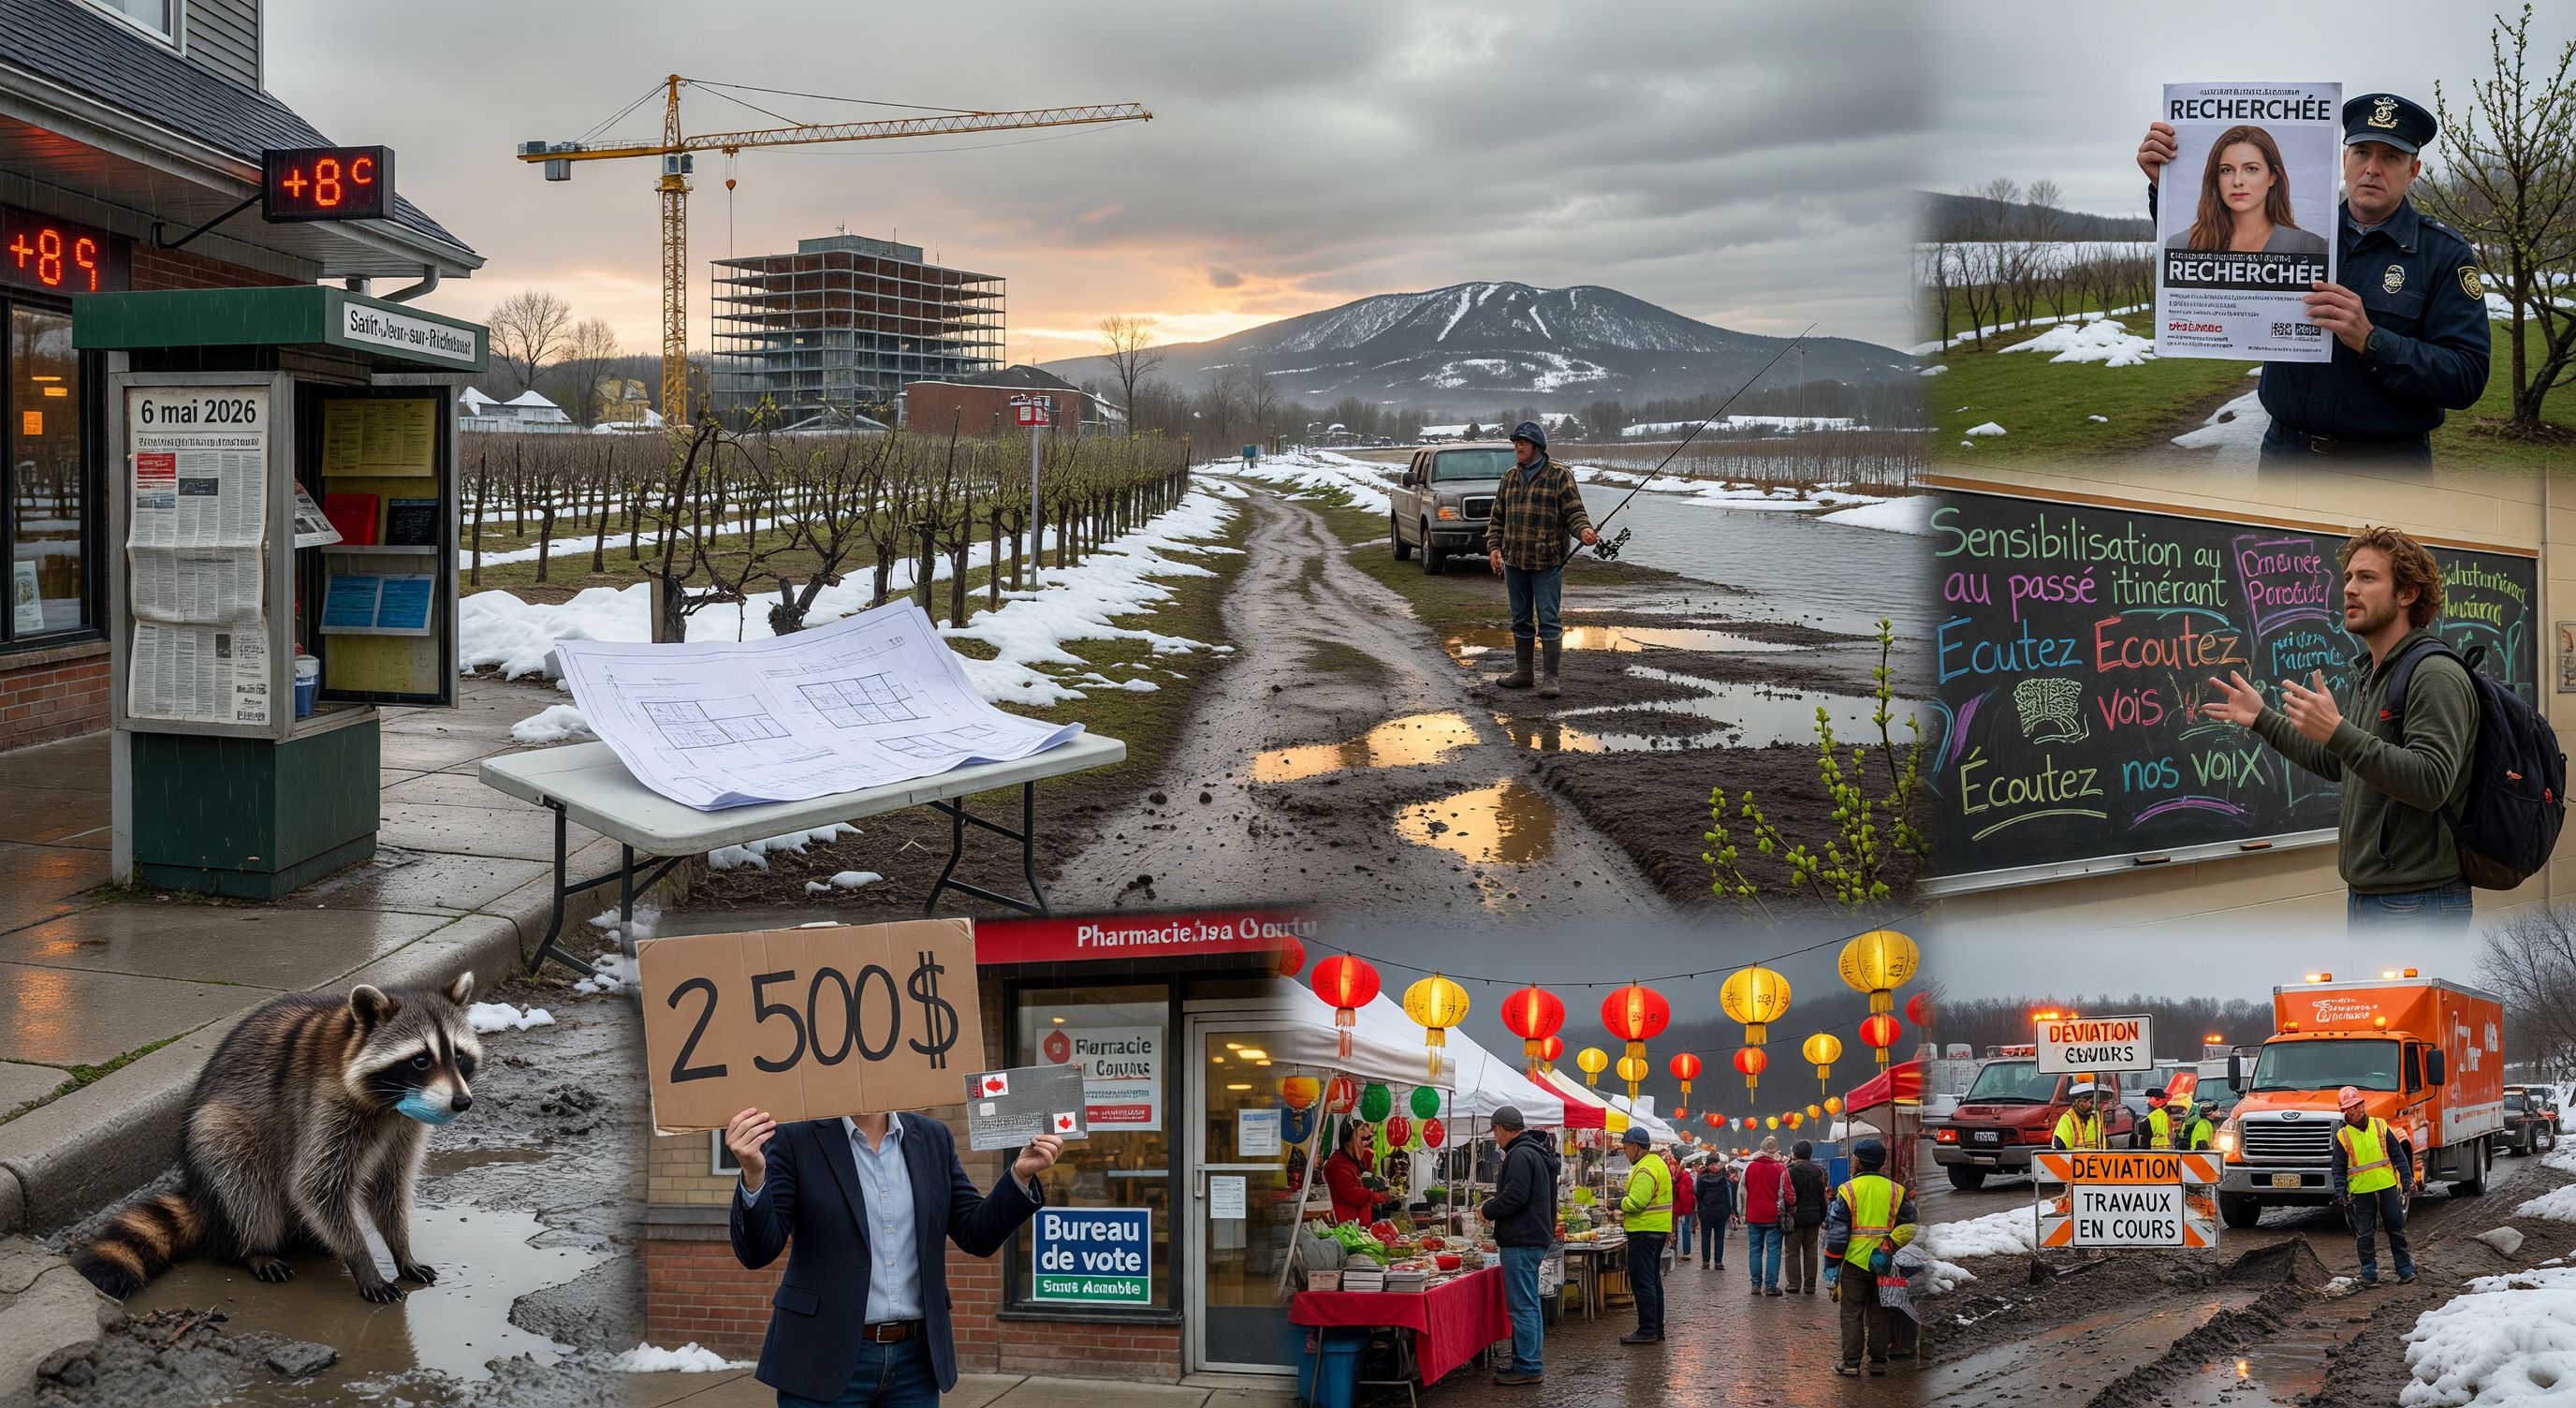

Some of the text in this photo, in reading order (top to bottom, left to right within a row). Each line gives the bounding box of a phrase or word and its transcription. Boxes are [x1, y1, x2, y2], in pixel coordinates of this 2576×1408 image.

[2170, 94, 2332, 121] RECHERCHÉE
[2168, 257, 2325, 285] RECHERCHÉE
[140, 399, 256, 424] 6 mai 2026
[1929, 506, 2221, 569] Sensibilisation au
[1944, 565, 2229, 623] au passé itinérant
[1960, 745, 2104, 815] Écoutez
[2122, 756, 2180, 793] nos
[1077, 921, 1192, 947] Pharmacie
[666, 976, 728, 1083] 2
[2049, 1020, 2140, 1044] DÉVIATION
[2072, 1156, 2181, 1180] DÉVIATION
[2083, 1192, 2172, 1213] TRAVAUX
[1044, 1214, 1140, 1242] Bureau
[2080, 1219, 2176, 1239] EN COURS
[1041, 1243, 1142, 1272] de vote
